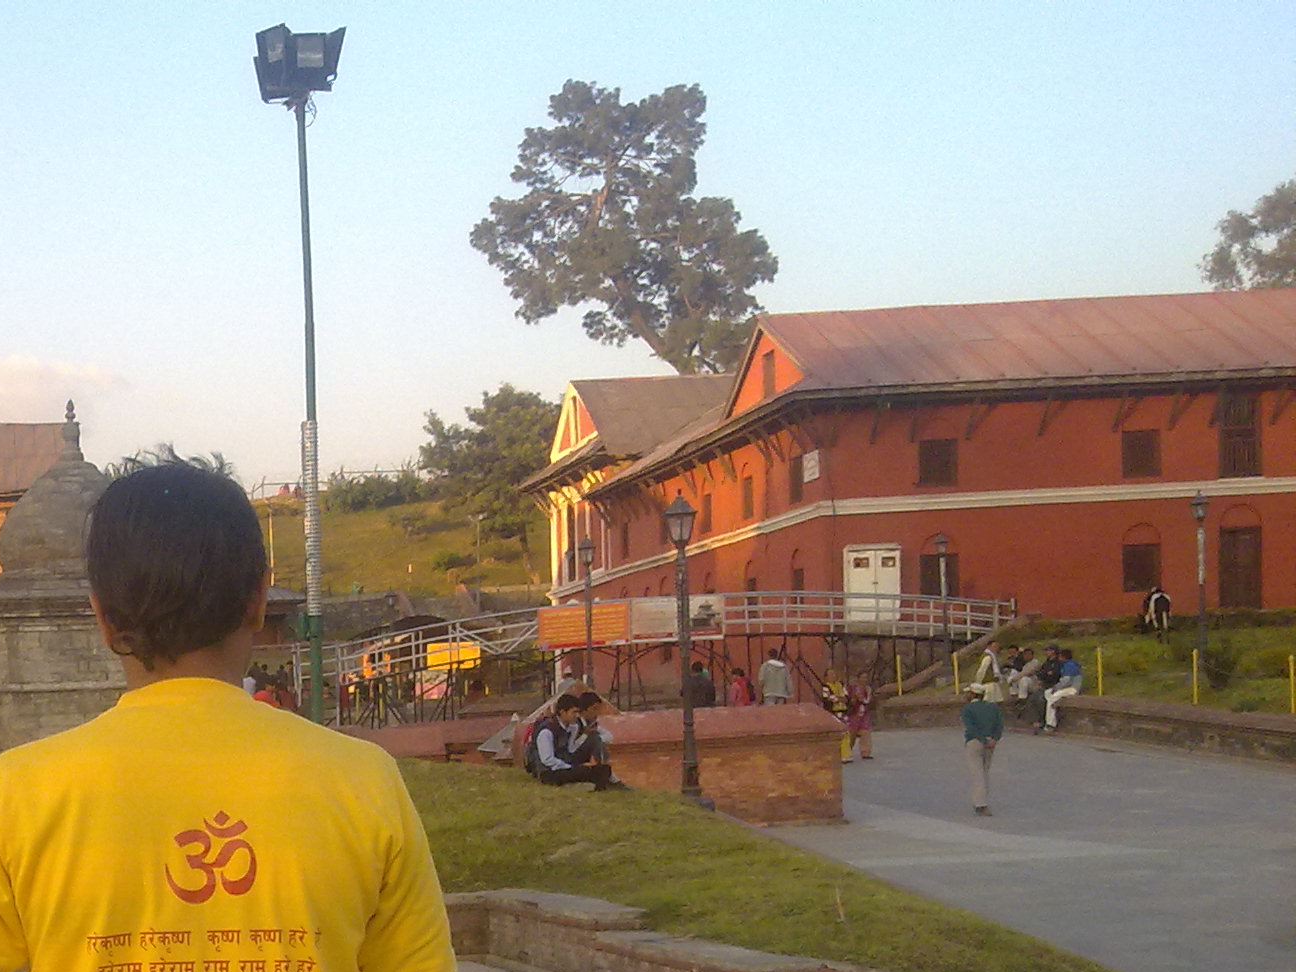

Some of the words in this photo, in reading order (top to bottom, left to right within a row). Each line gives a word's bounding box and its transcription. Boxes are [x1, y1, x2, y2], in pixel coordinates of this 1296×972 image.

[206, 929, 241, 953] कृष्ण
[249, 929, 283, 952] कृष्ण
[288, 926, 308, 949] हरे
